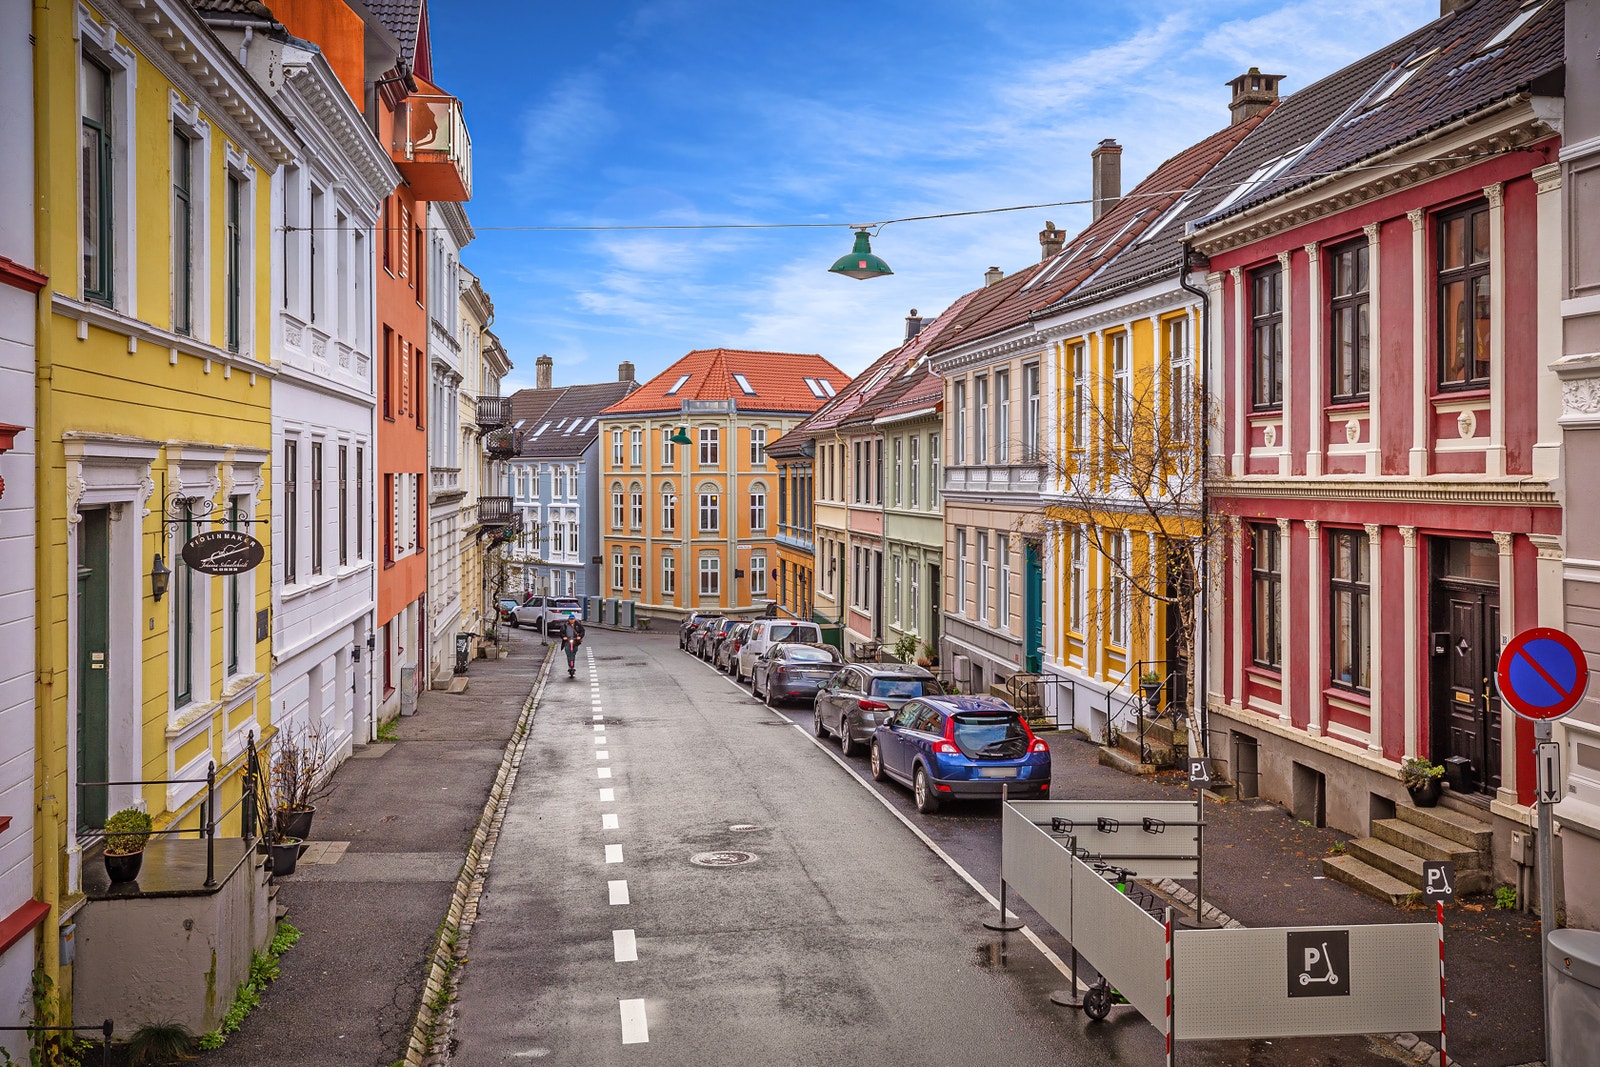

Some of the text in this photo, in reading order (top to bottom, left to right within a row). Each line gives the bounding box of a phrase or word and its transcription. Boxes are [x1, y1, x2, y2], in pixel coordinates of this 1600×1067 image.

[190, 533, 256, 548] FIOLINMAKER
[1192, 763, 1201, 775] P
[1428, 868, 1441, 885] P
[1304, 947, 1320, 971] P
